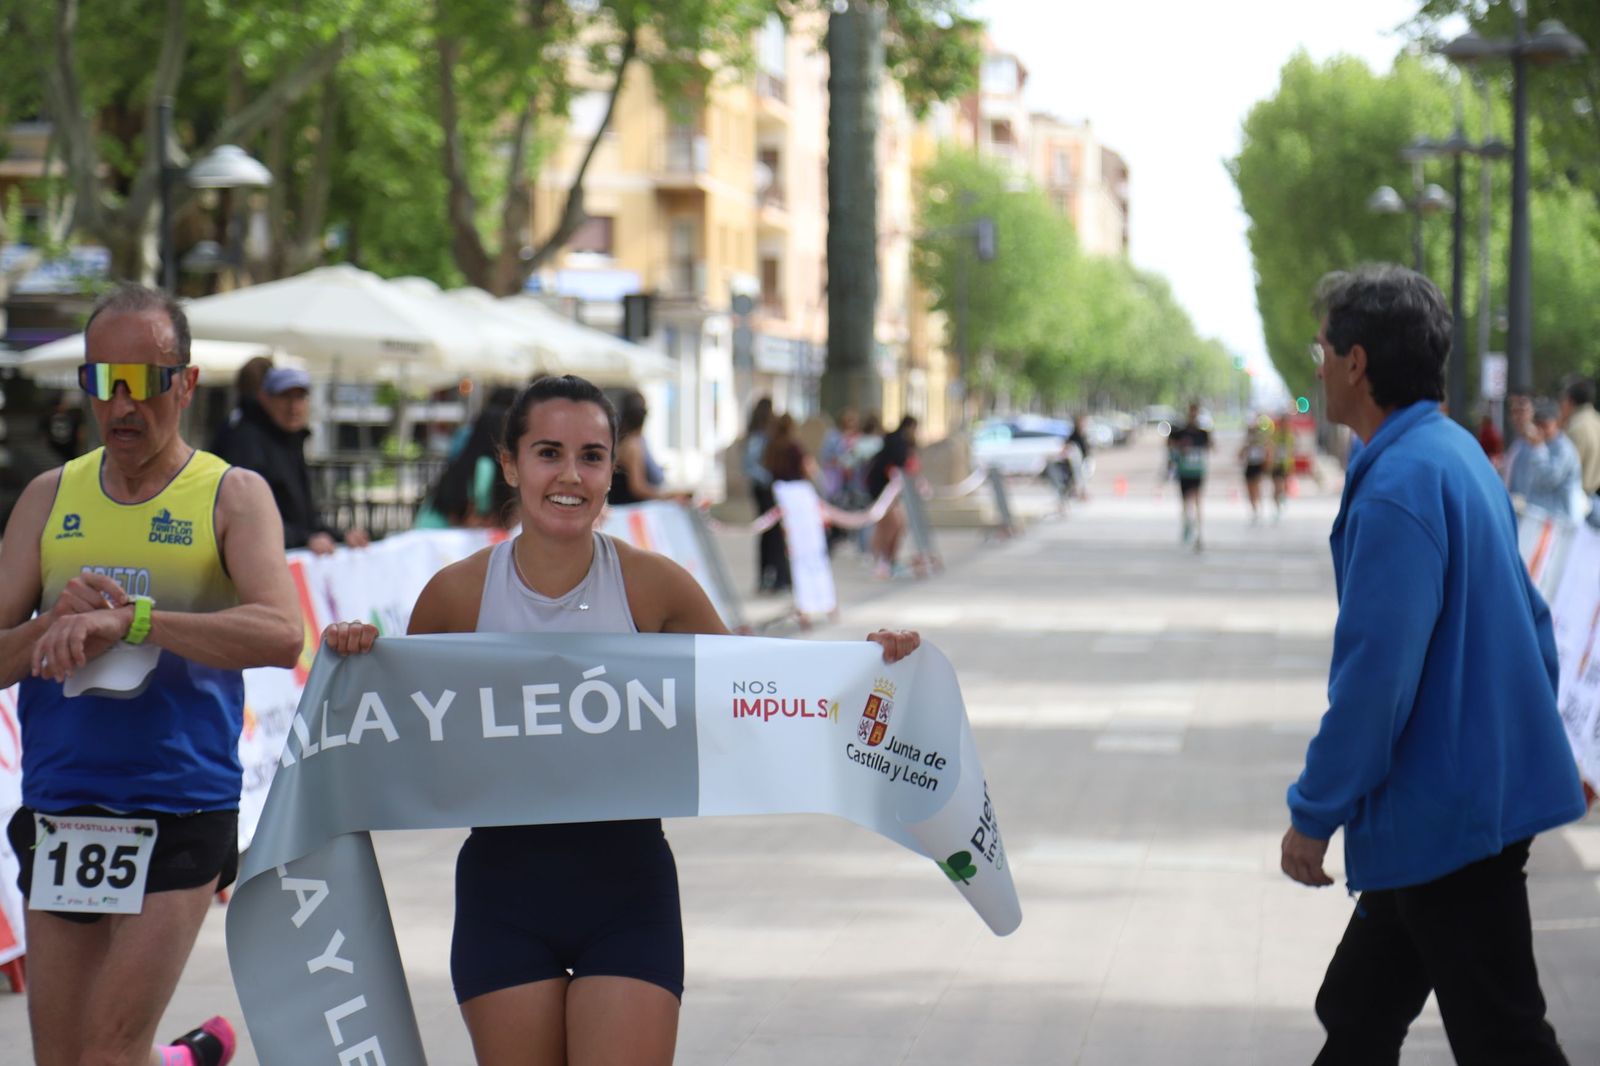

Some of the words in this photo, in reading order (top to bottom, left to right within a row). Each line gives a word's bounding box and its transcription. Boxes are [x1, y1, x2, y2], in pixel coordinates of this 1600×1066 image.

[149, 532, 192, 546] DUERO
[80, 566, 150, 597] ETO
[410, 689, 457, 741] Y
[479, 665, 677, 738] LEÓN
[733, 681, 777, 694] NOS
[846, 743, 891, 775] Castilla
[889, 764, 902, 782] y
[902, 766, 939, 791] León
[885, 736, 921, 762] Junta
[923, 752, 947, 770] de
[48, 842, 139, 889] 185
[307, 929, 354, 975] Y
